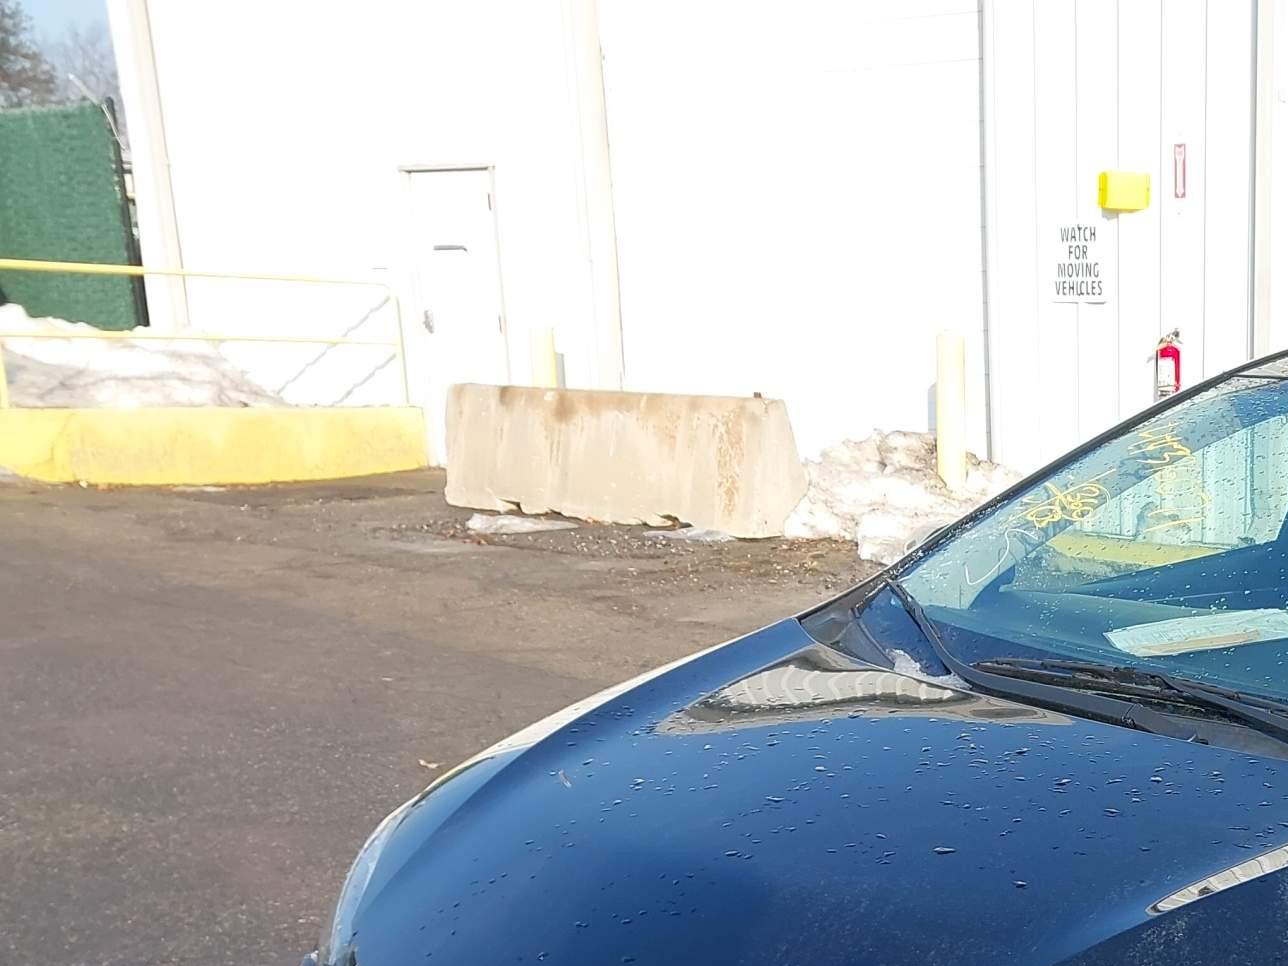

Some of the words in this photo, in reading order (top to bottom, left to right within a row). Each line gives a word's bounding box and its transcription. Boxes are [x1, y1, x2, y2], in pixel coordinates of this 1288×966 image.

[1060, 225, 1096, 242] WATCH
[1068, 244, 1088, 260] FOR
[1057, 262, 1100, 278] MOVING
[1055, 280, 1103, 296] VEHICLES
